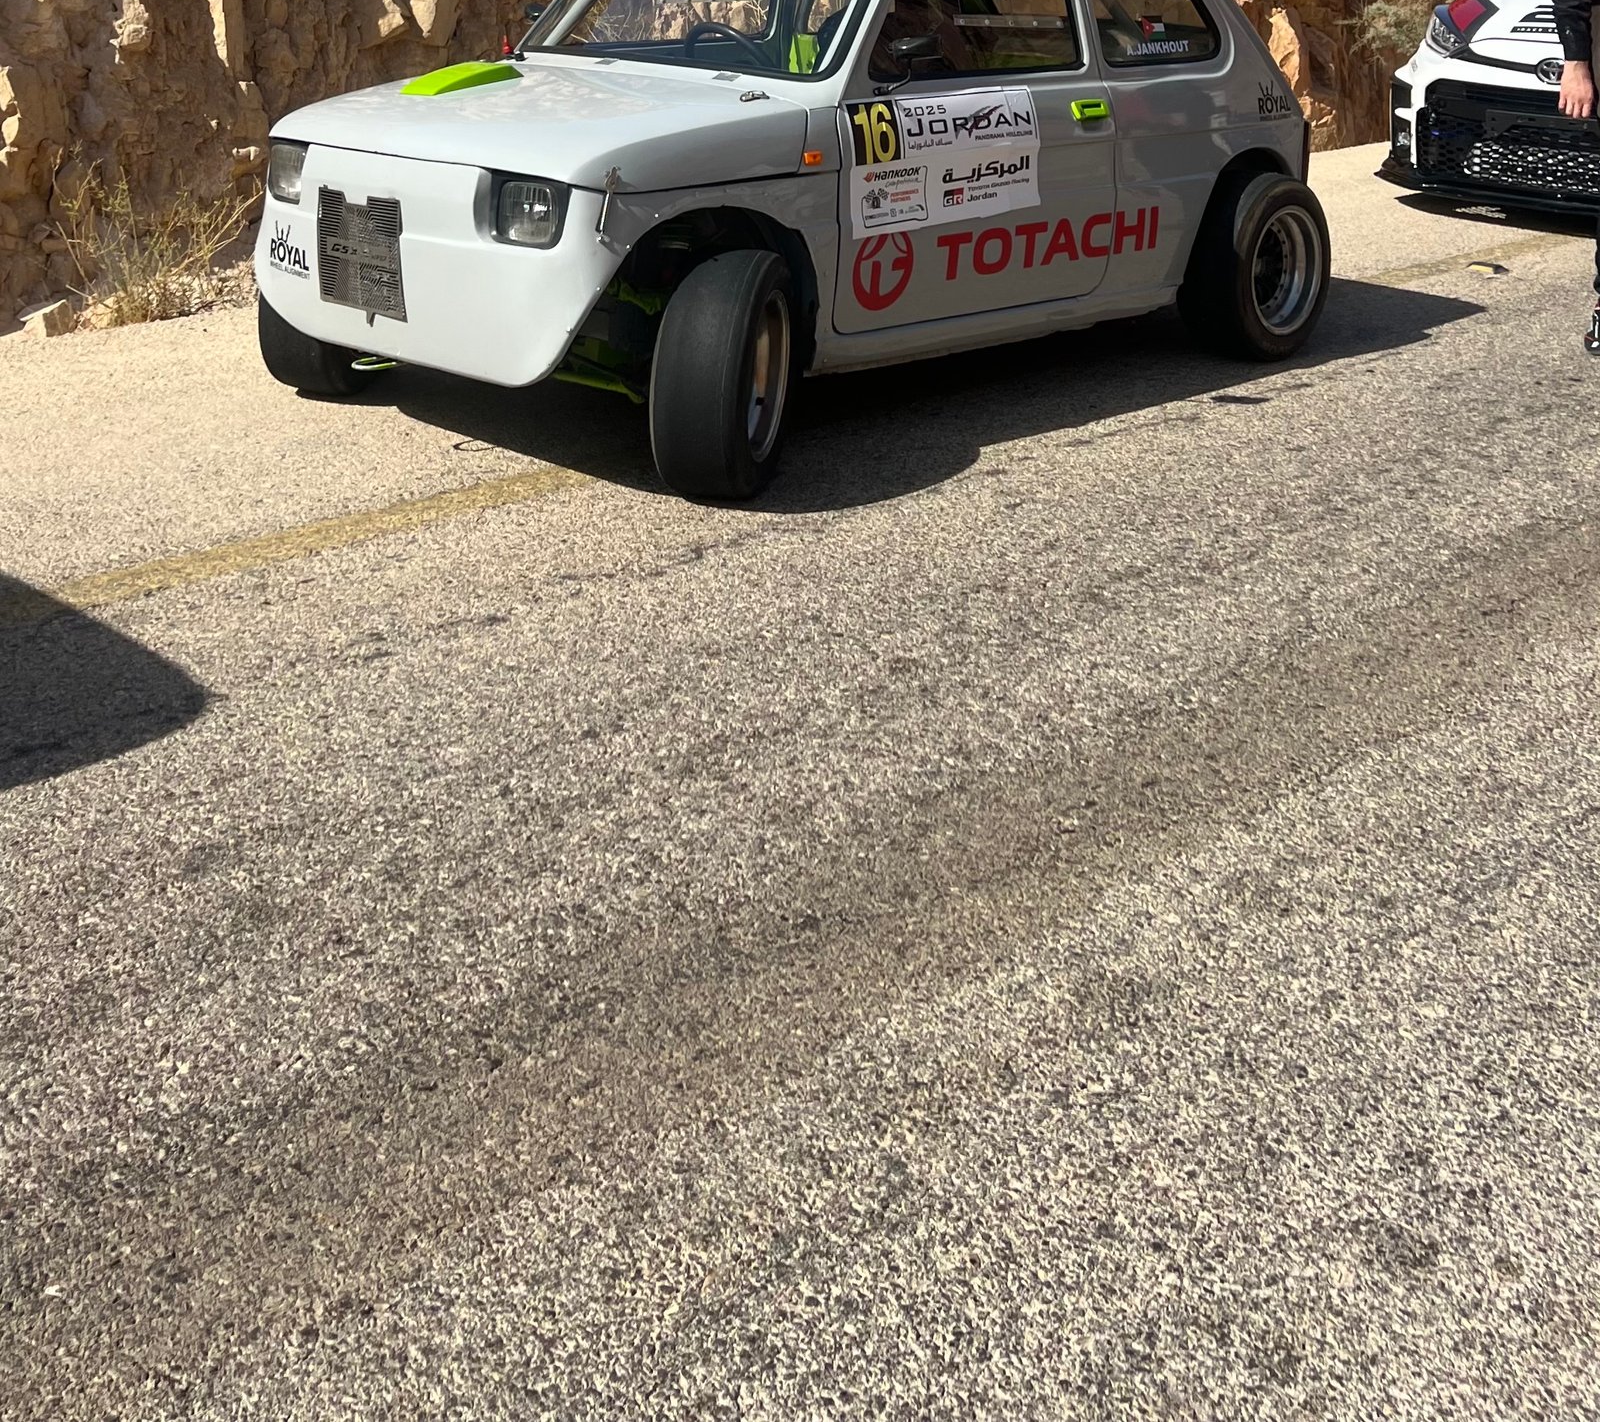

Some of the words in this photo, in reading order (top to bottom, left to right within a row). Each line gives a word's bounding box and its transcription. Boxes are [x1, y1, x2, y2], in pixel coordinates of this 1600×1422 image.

[1126, 40, 1189, 56] A.JANKHOUT
[903, 105, 947, 117] 2025
[1258, 95, 1291, 114] ROYAL
[853, 103, 896, 164] 16
[907, 111, 1032, 138] JORDAN
[942, 155, 1030, 184] المركزية
[944, 194, 963, 206] GR
[967, 191, 998, 202] Jordan
[270, 237, 309, 271] ROYAL
[936, 206, 1159, 281] TOTACHI
